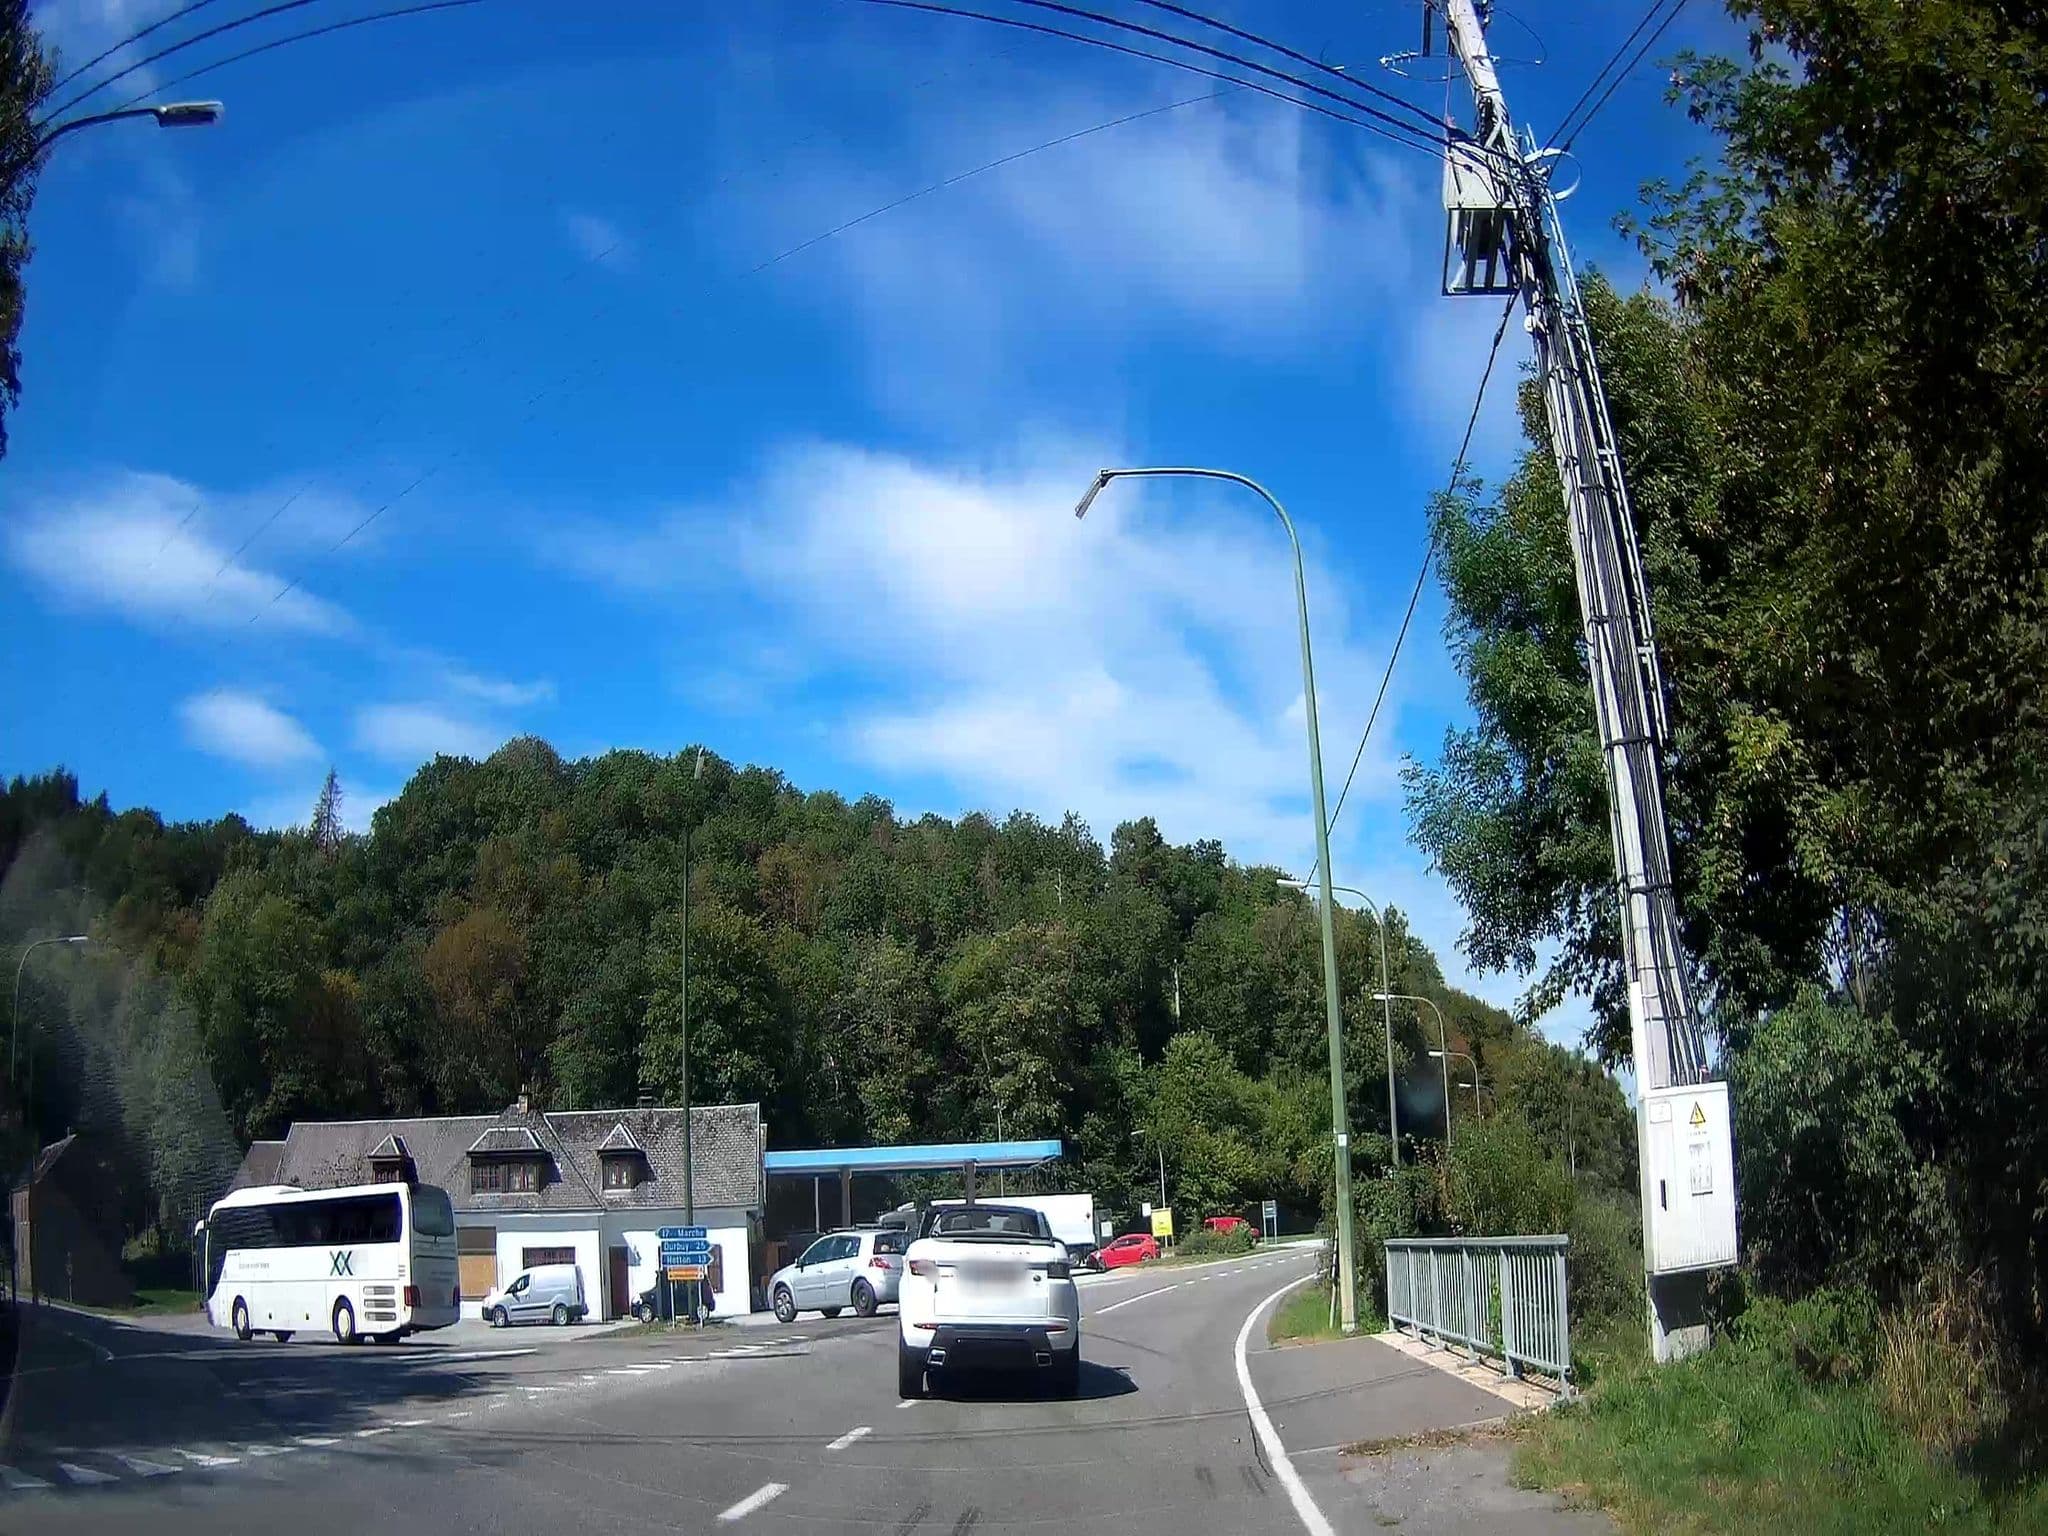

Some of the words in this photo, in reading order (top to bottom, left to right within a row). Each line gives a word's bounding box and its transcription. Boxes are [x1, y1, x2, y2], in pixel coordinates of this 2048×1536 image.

[677, 1229, 704, 1237] Marche
[663, 1242, 689, 1252] Durbuy
[667, 1255, 691, 1263] Hotton
